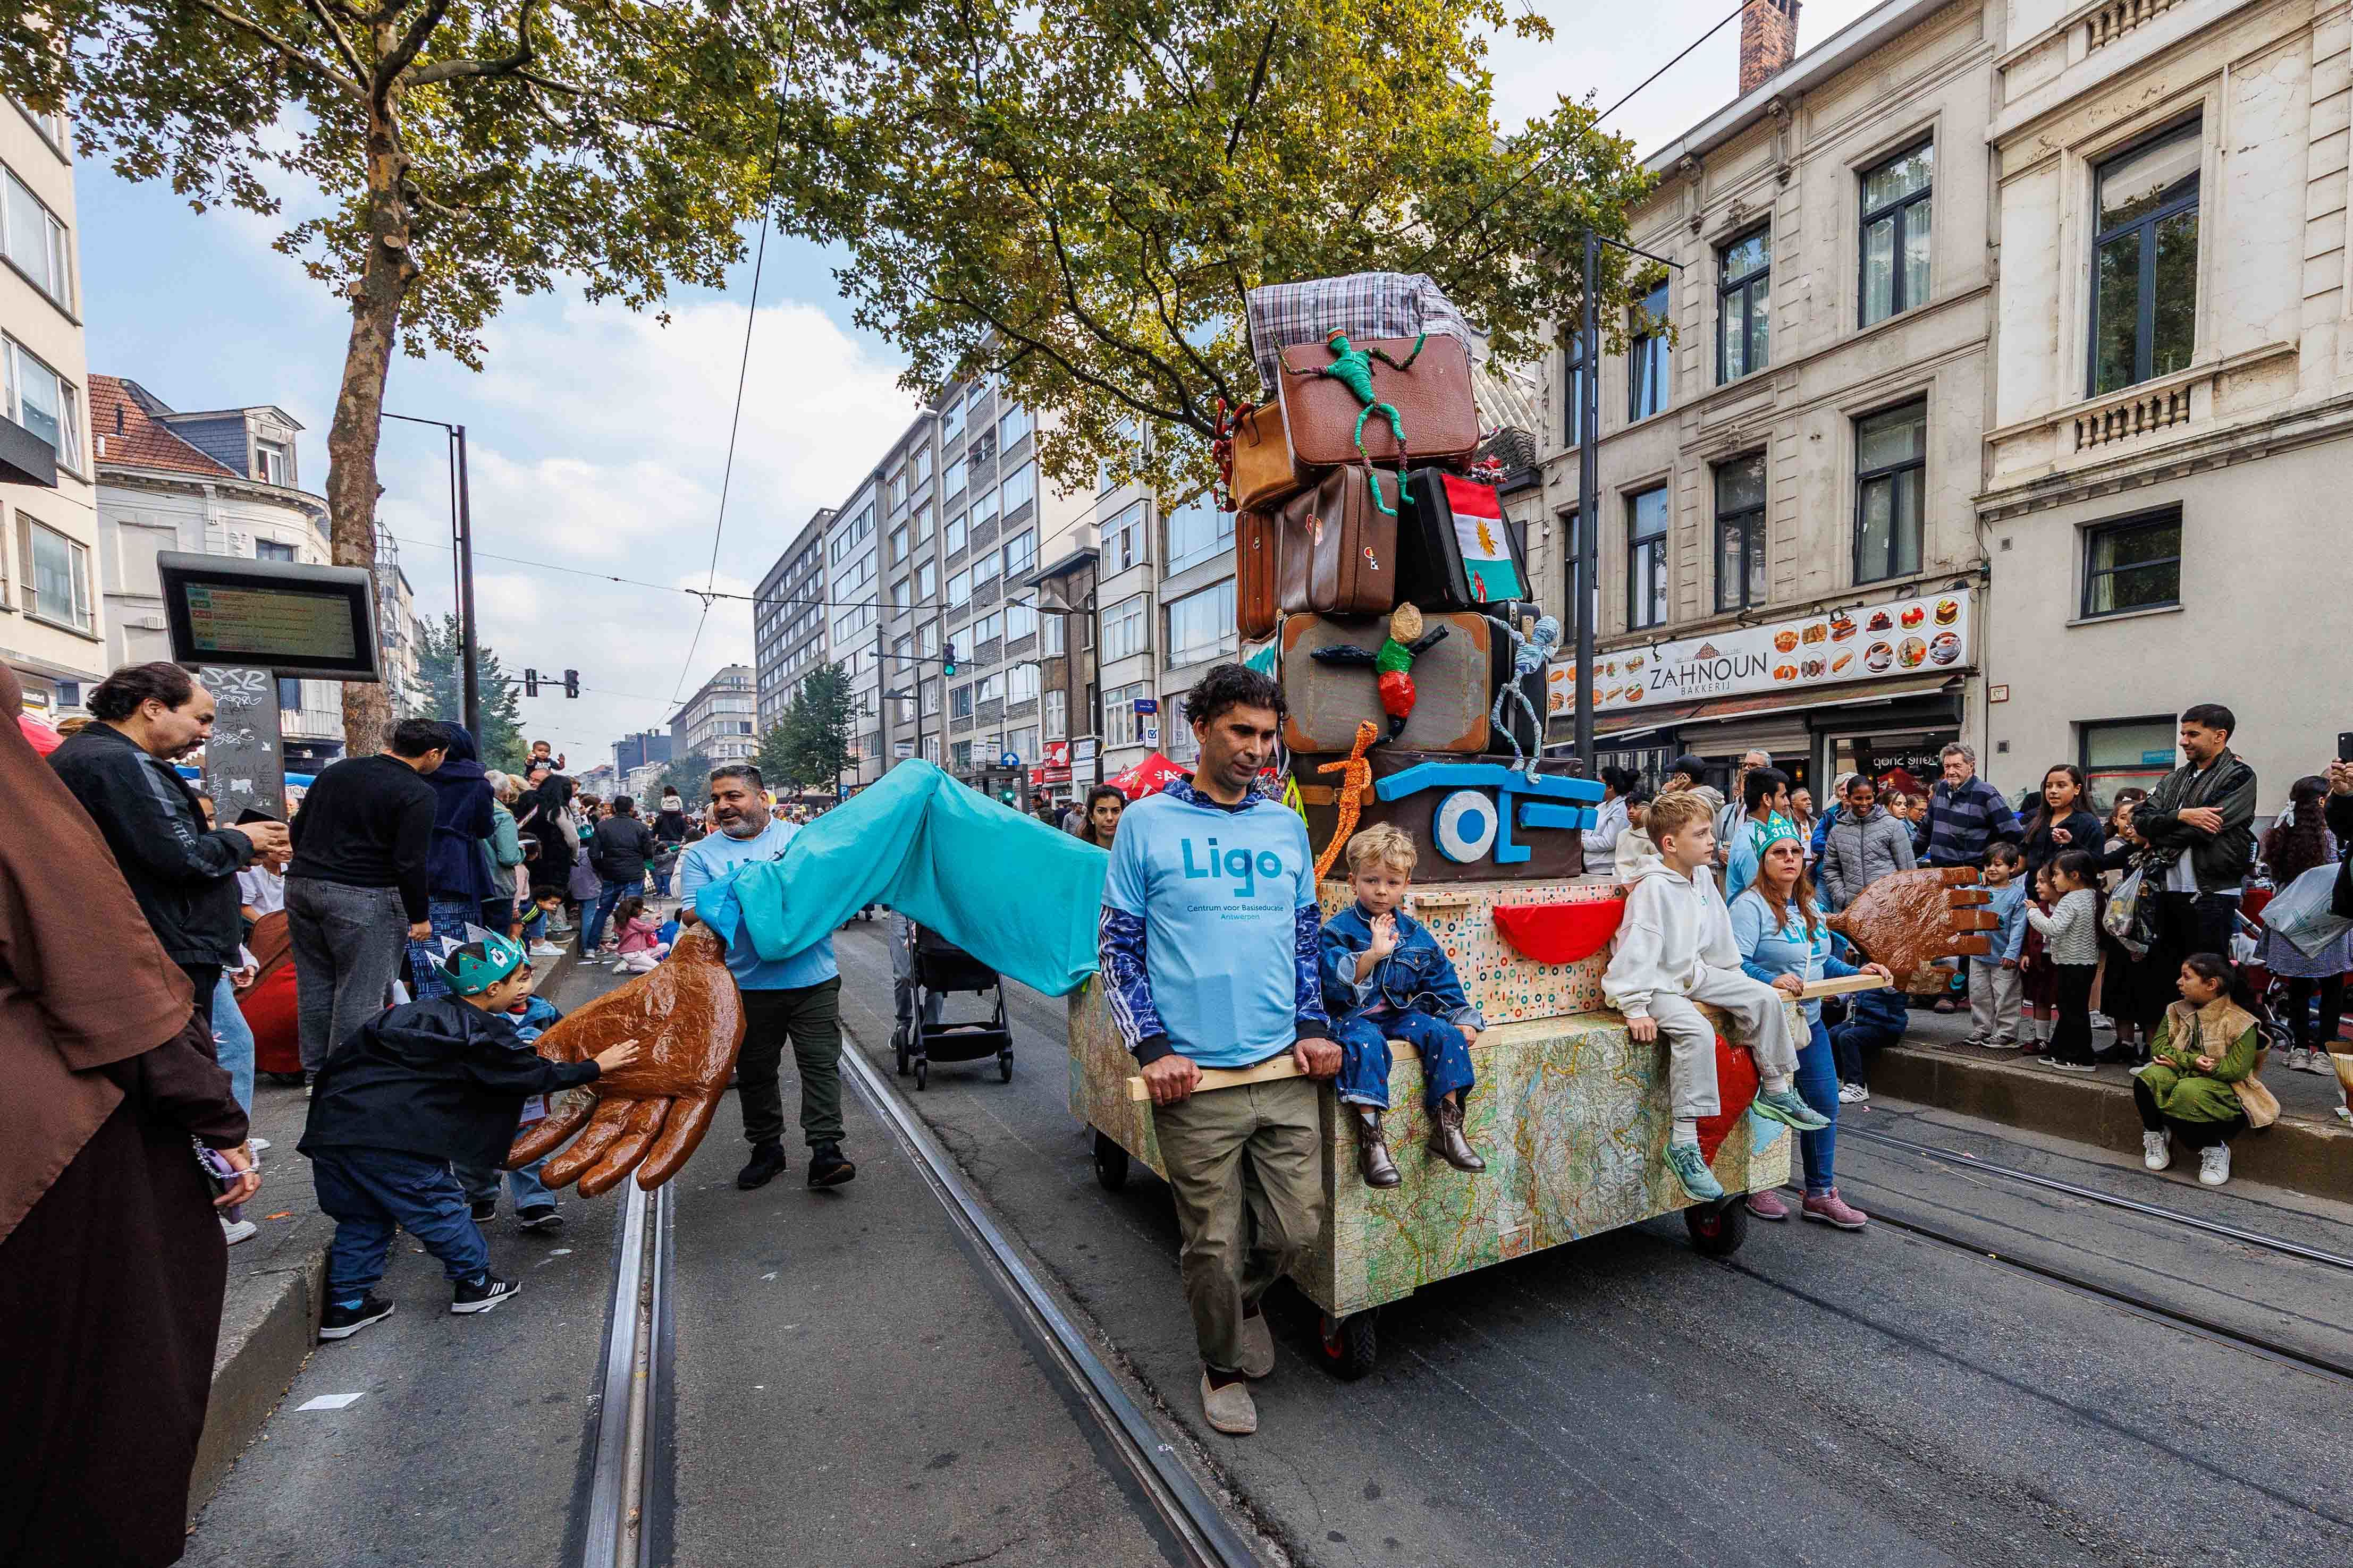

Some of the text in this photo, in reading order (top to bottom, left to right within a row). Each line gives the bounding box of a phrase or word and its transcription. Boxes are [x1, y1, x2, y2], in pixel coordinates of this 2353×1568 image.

[1650, 652, 1767, 690] ZAHNOUN
[1681, 681, 1730, 696] BAKKERIJ
[1771, 826, 1792, 838] 313
[1180, 837, 1283, 897] Ligo
[1781, 921, 1828, 955] Lio
